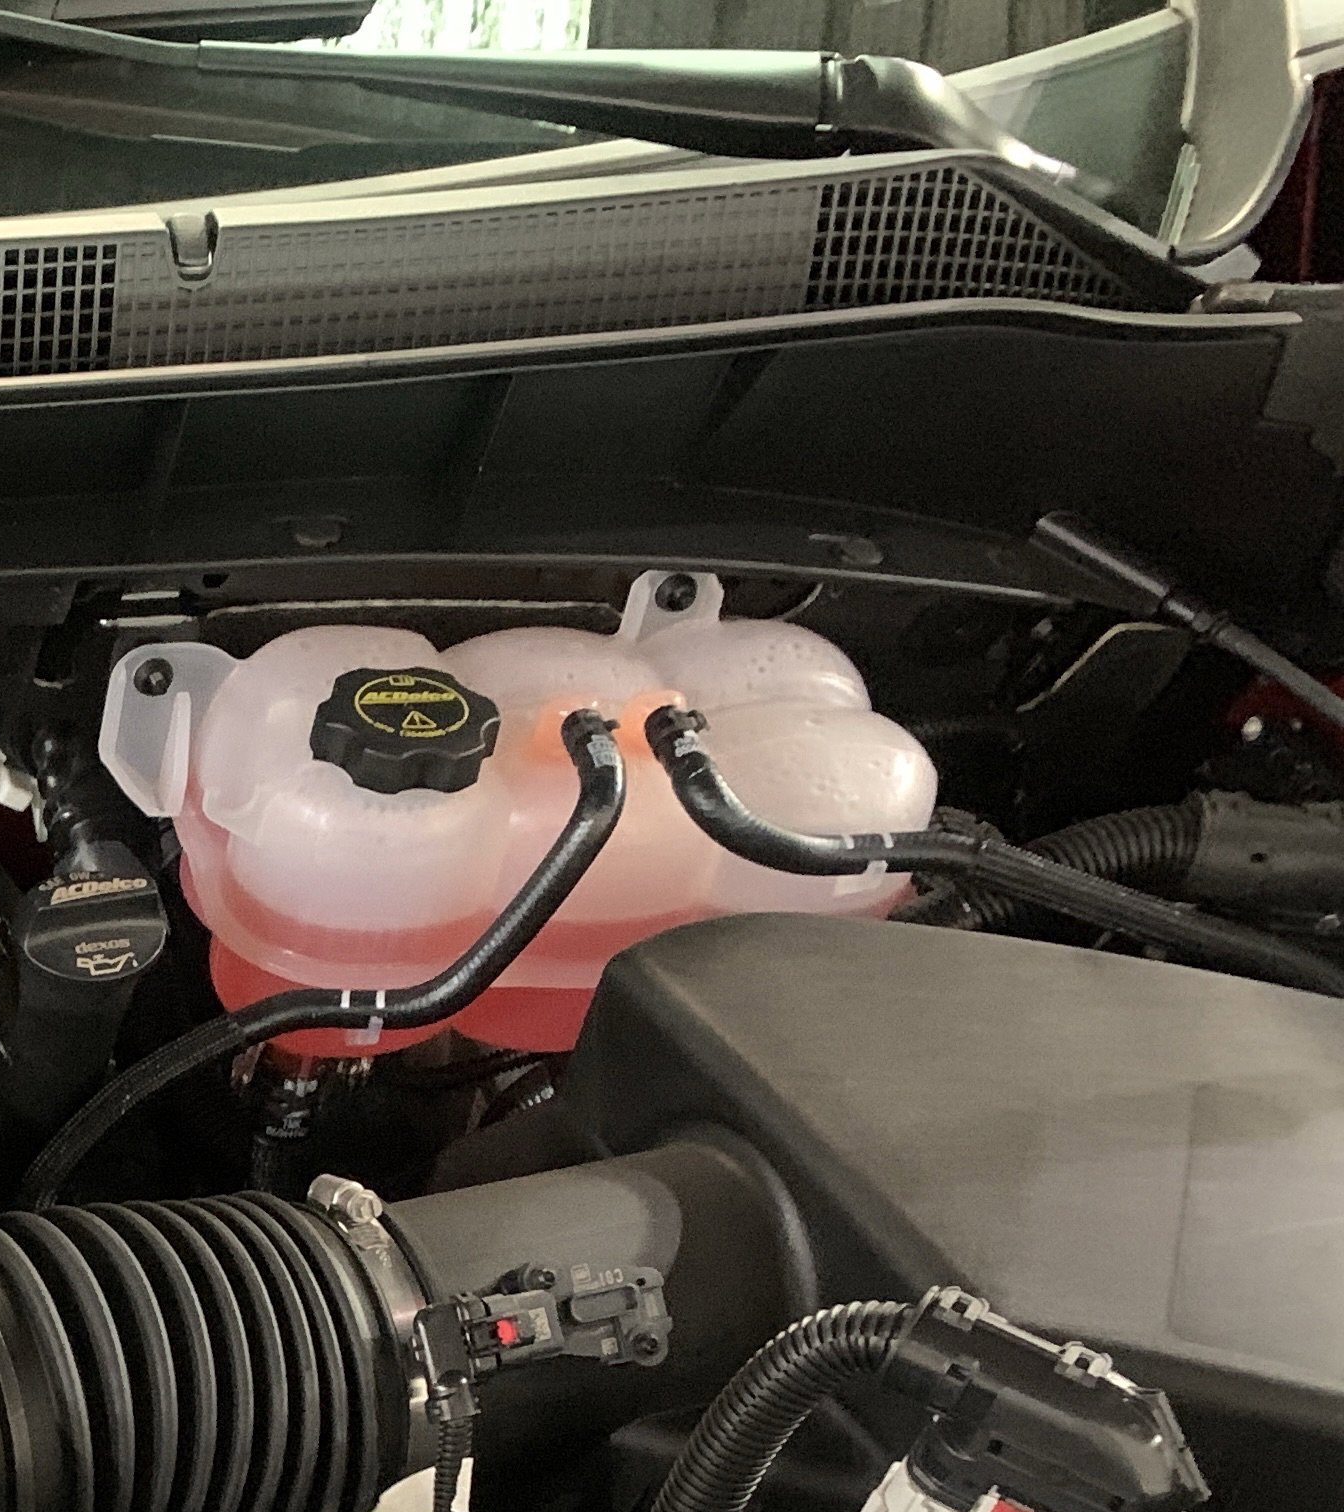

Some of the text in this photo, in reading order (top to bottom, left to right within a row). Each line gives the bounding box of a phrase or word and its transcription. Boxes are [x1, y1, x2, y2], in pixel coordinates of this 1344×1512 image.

[360, 690, 457, 704] ACDelco
[50, 877, 148, 906] ACDelco
[74, 938, 130, 955] dexos
